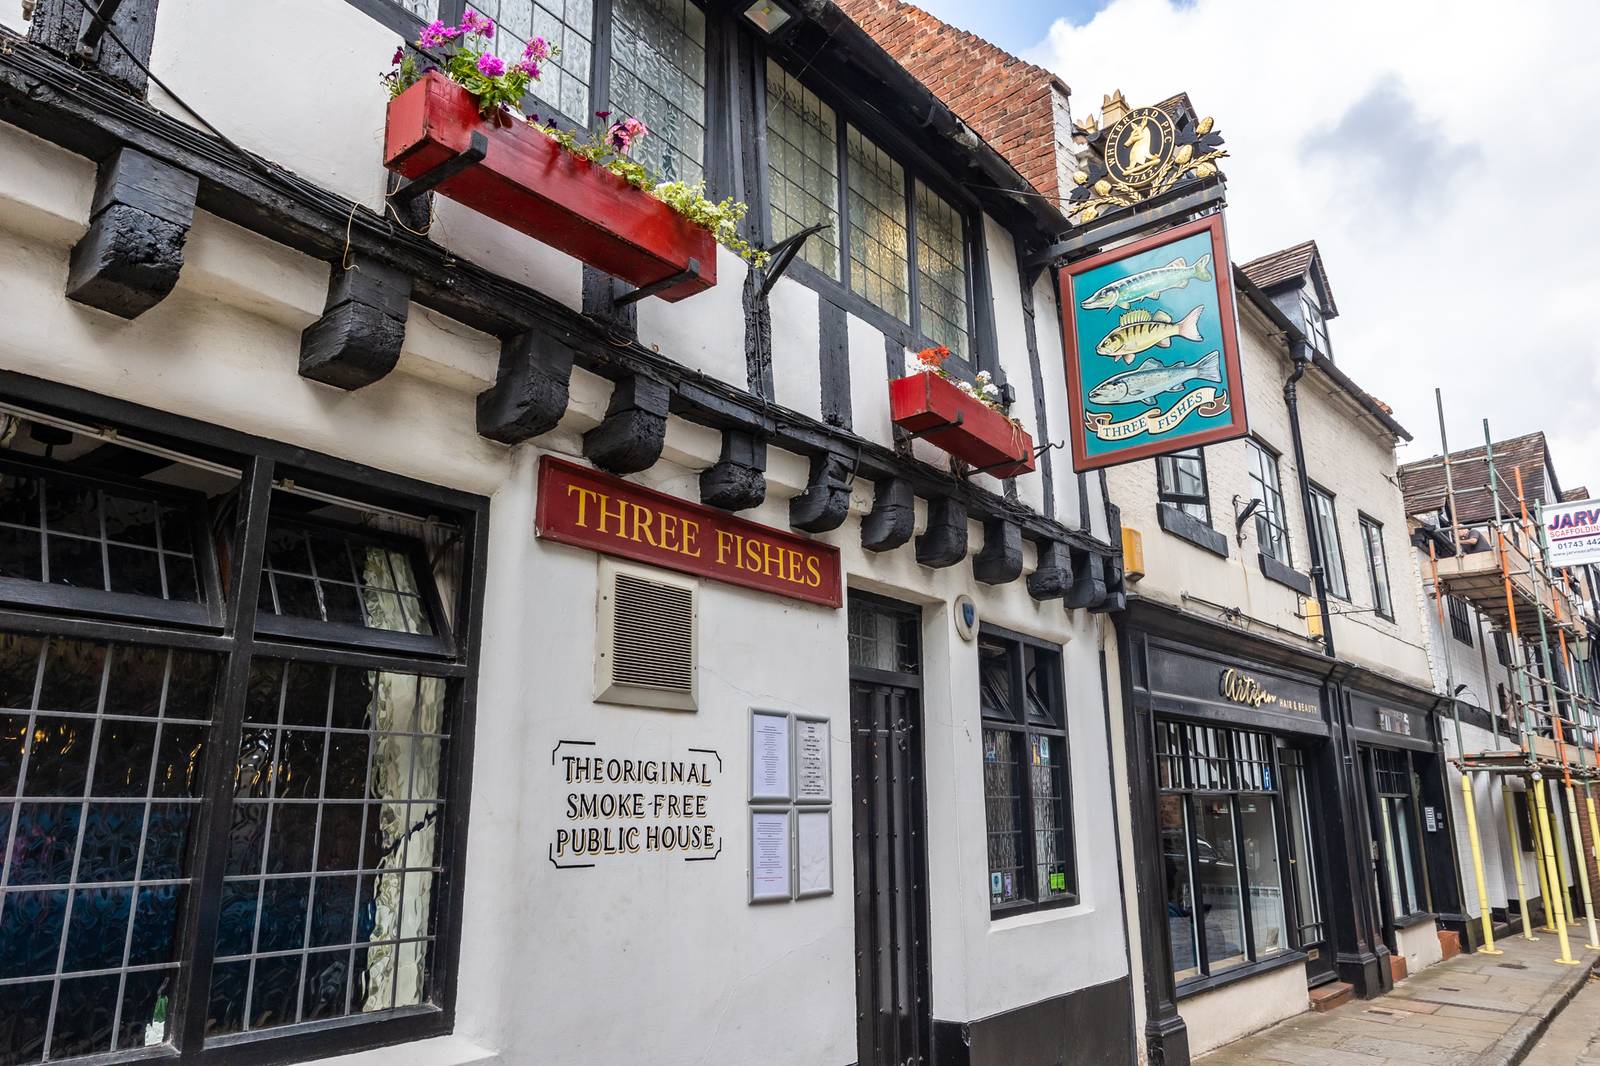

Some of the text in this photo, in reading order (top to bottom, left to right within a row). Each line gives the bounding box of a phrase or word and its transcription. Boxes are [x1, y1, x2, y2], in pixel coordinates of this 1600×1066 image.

[1107, 109, 1158, 166] WHITBREAD
[1103, 392, 1203, 438] THREE FISHES
[567, 484, 821, 588] THREE FISHES
[1558, 541, 1583, 549] 01743
[562, 756, 712, 786] THE ORIGINAL
[566, 793, 708, 820] SMOKE-FREE
[556, 825, 715, 857] PUBLIC HOUSE
